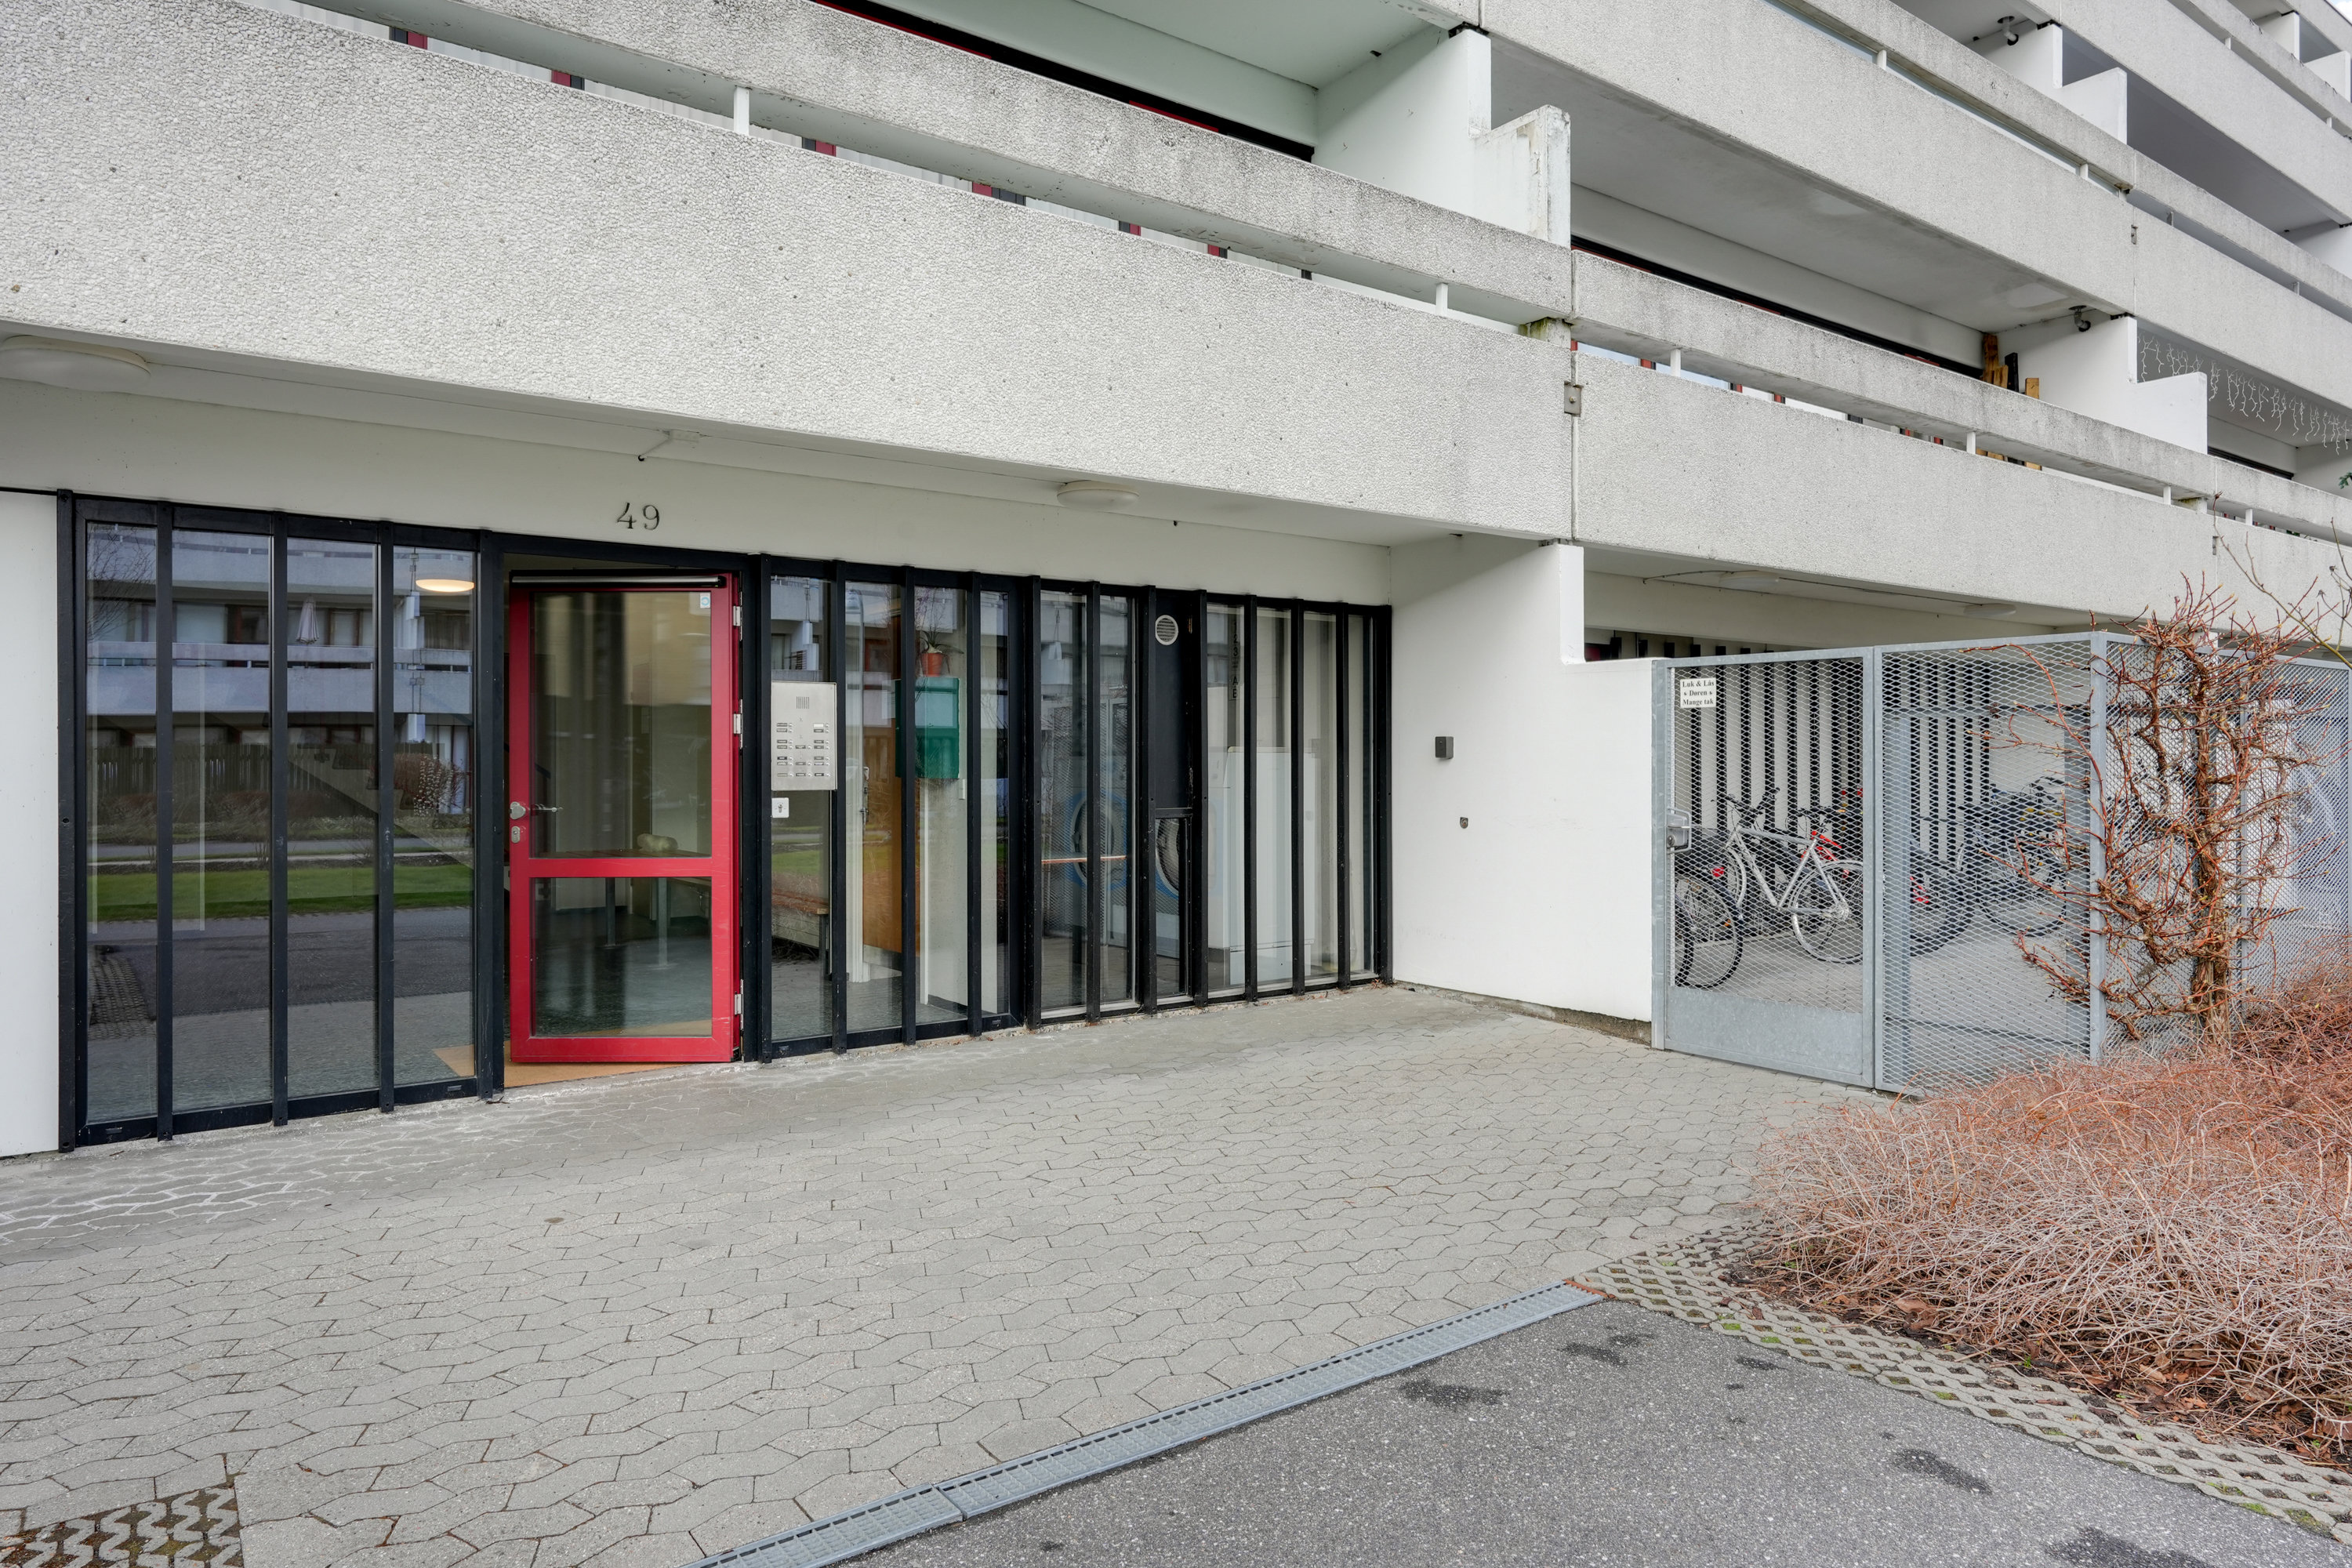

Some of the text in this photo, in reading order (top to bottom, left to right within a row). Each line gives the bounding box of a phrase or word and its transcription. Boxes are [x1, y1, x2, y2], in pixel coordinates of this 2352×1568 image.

[616, 502, 659, 530] 49
[1233, 634, 1238, 644] 2
[1233, 647, 1238, 656] 3
[1232, 676, 1238, 686] A
